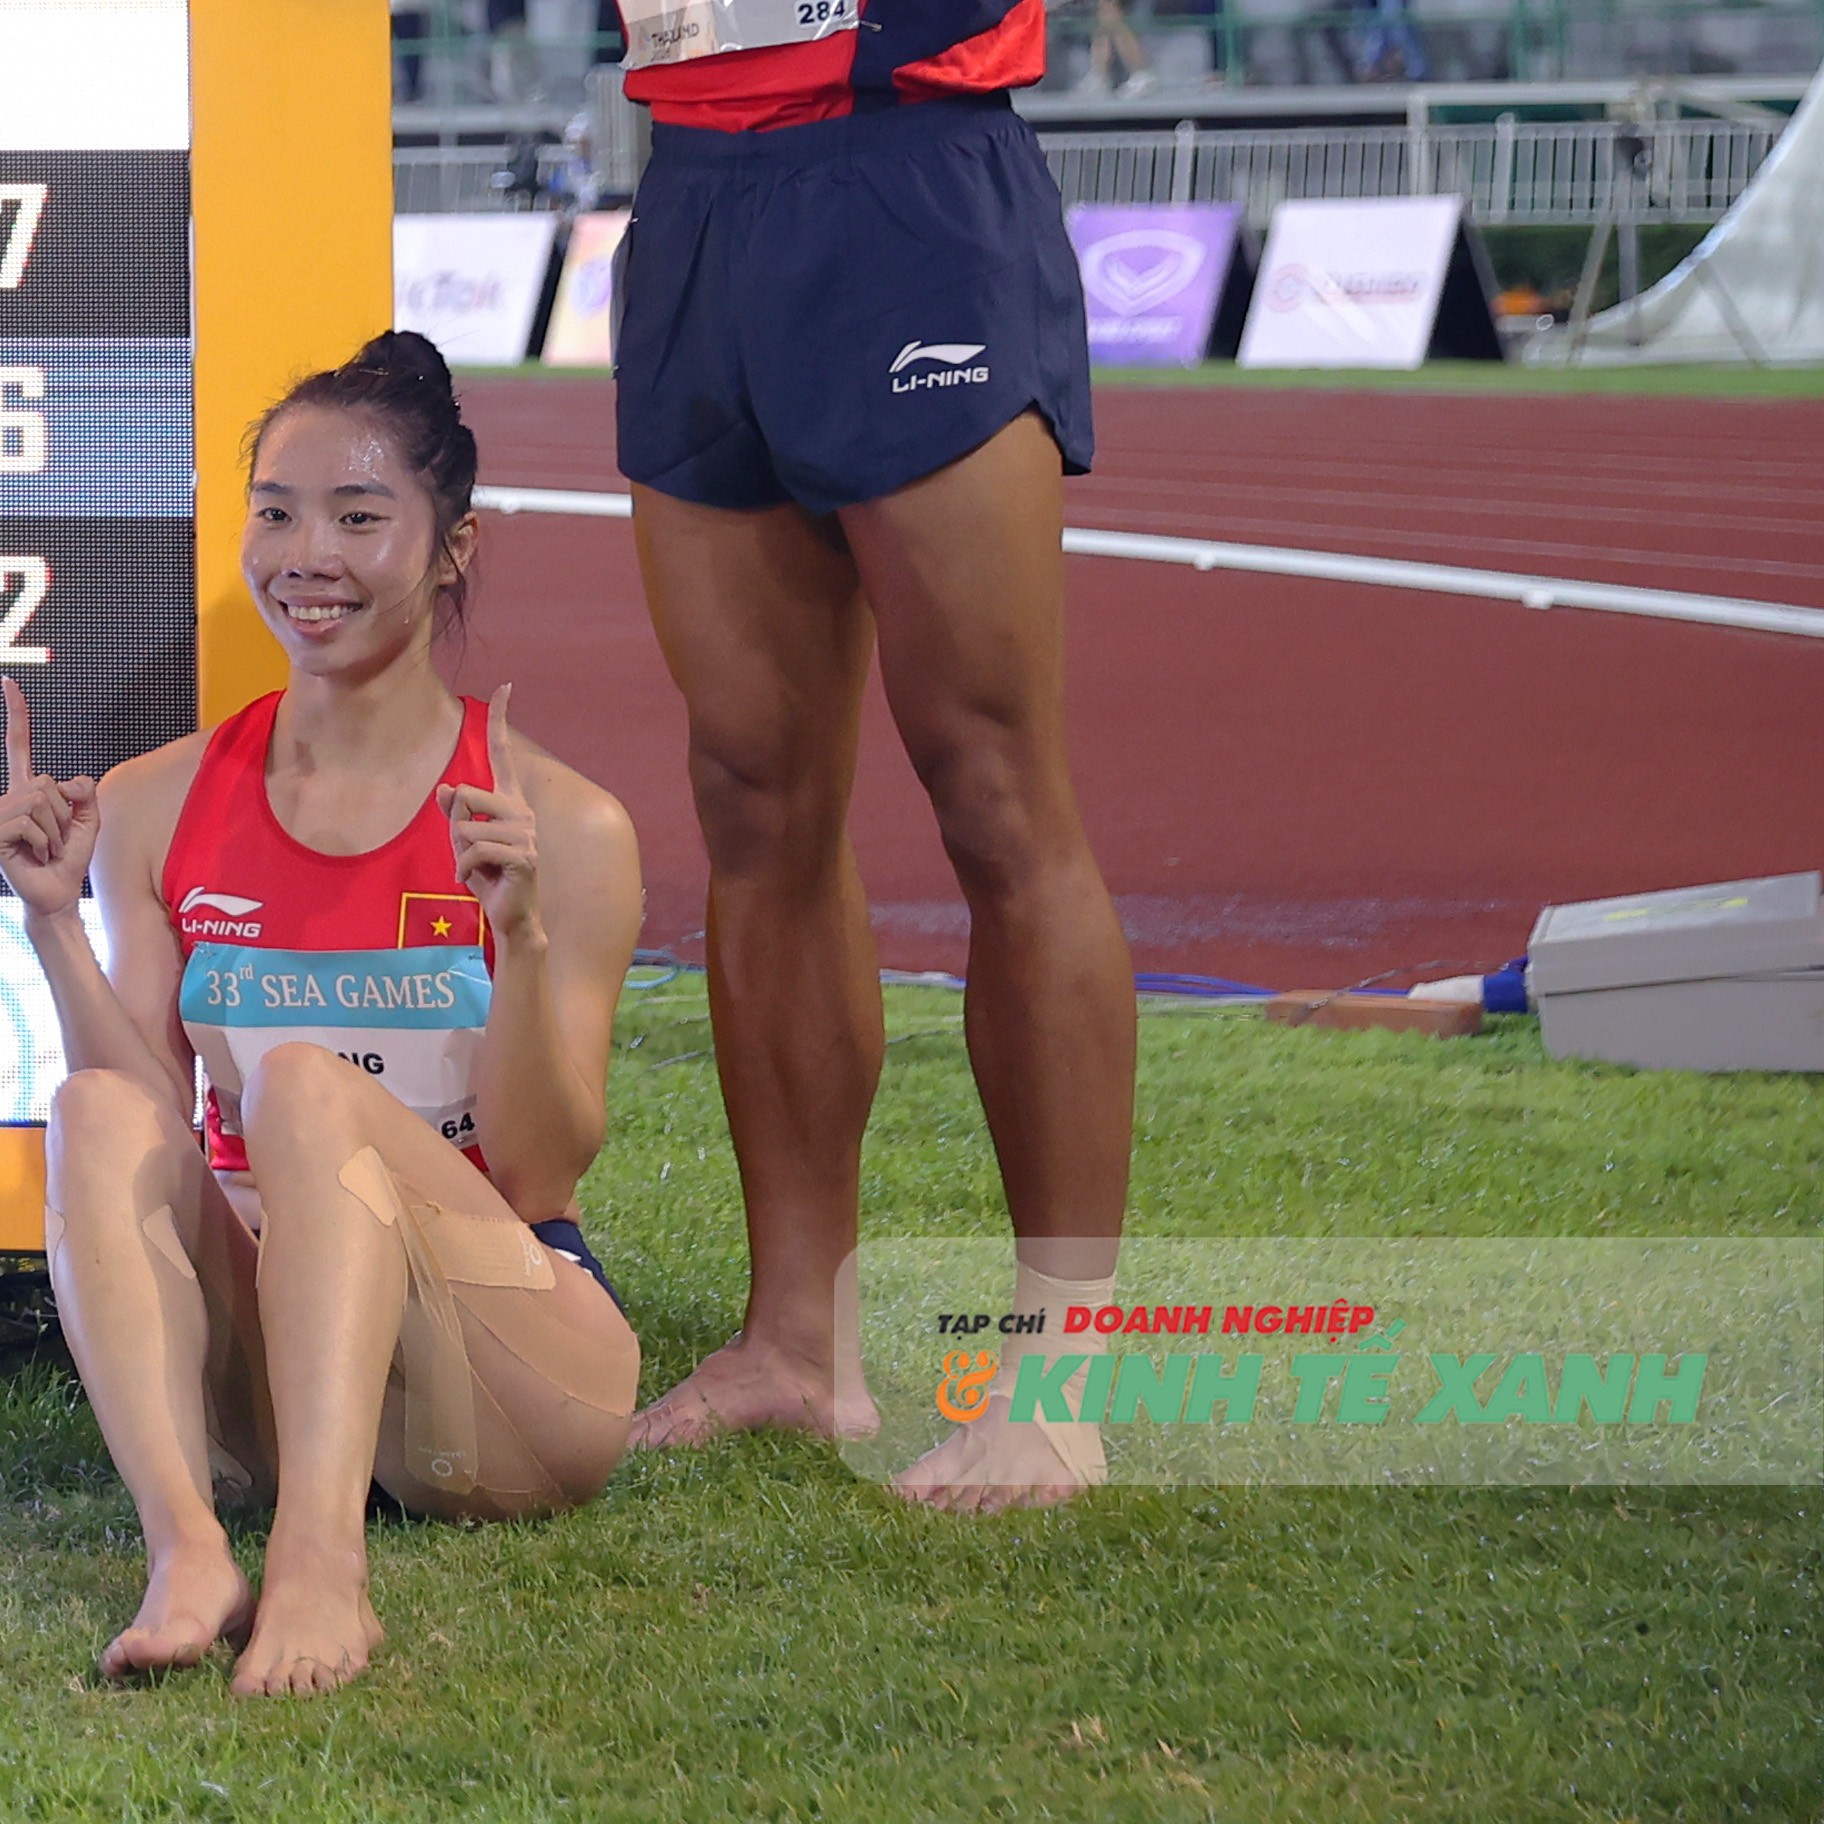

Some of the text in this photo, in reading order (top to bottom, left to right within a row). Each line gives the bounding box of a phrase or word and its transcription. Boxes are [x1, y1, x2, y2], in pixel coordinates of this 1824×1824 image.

[890, 363, 990, 395] LI-NING
[181, 916, 263, 939] LI-NING
[206, 962, 456, 1009] 33rd SEA GAMES
